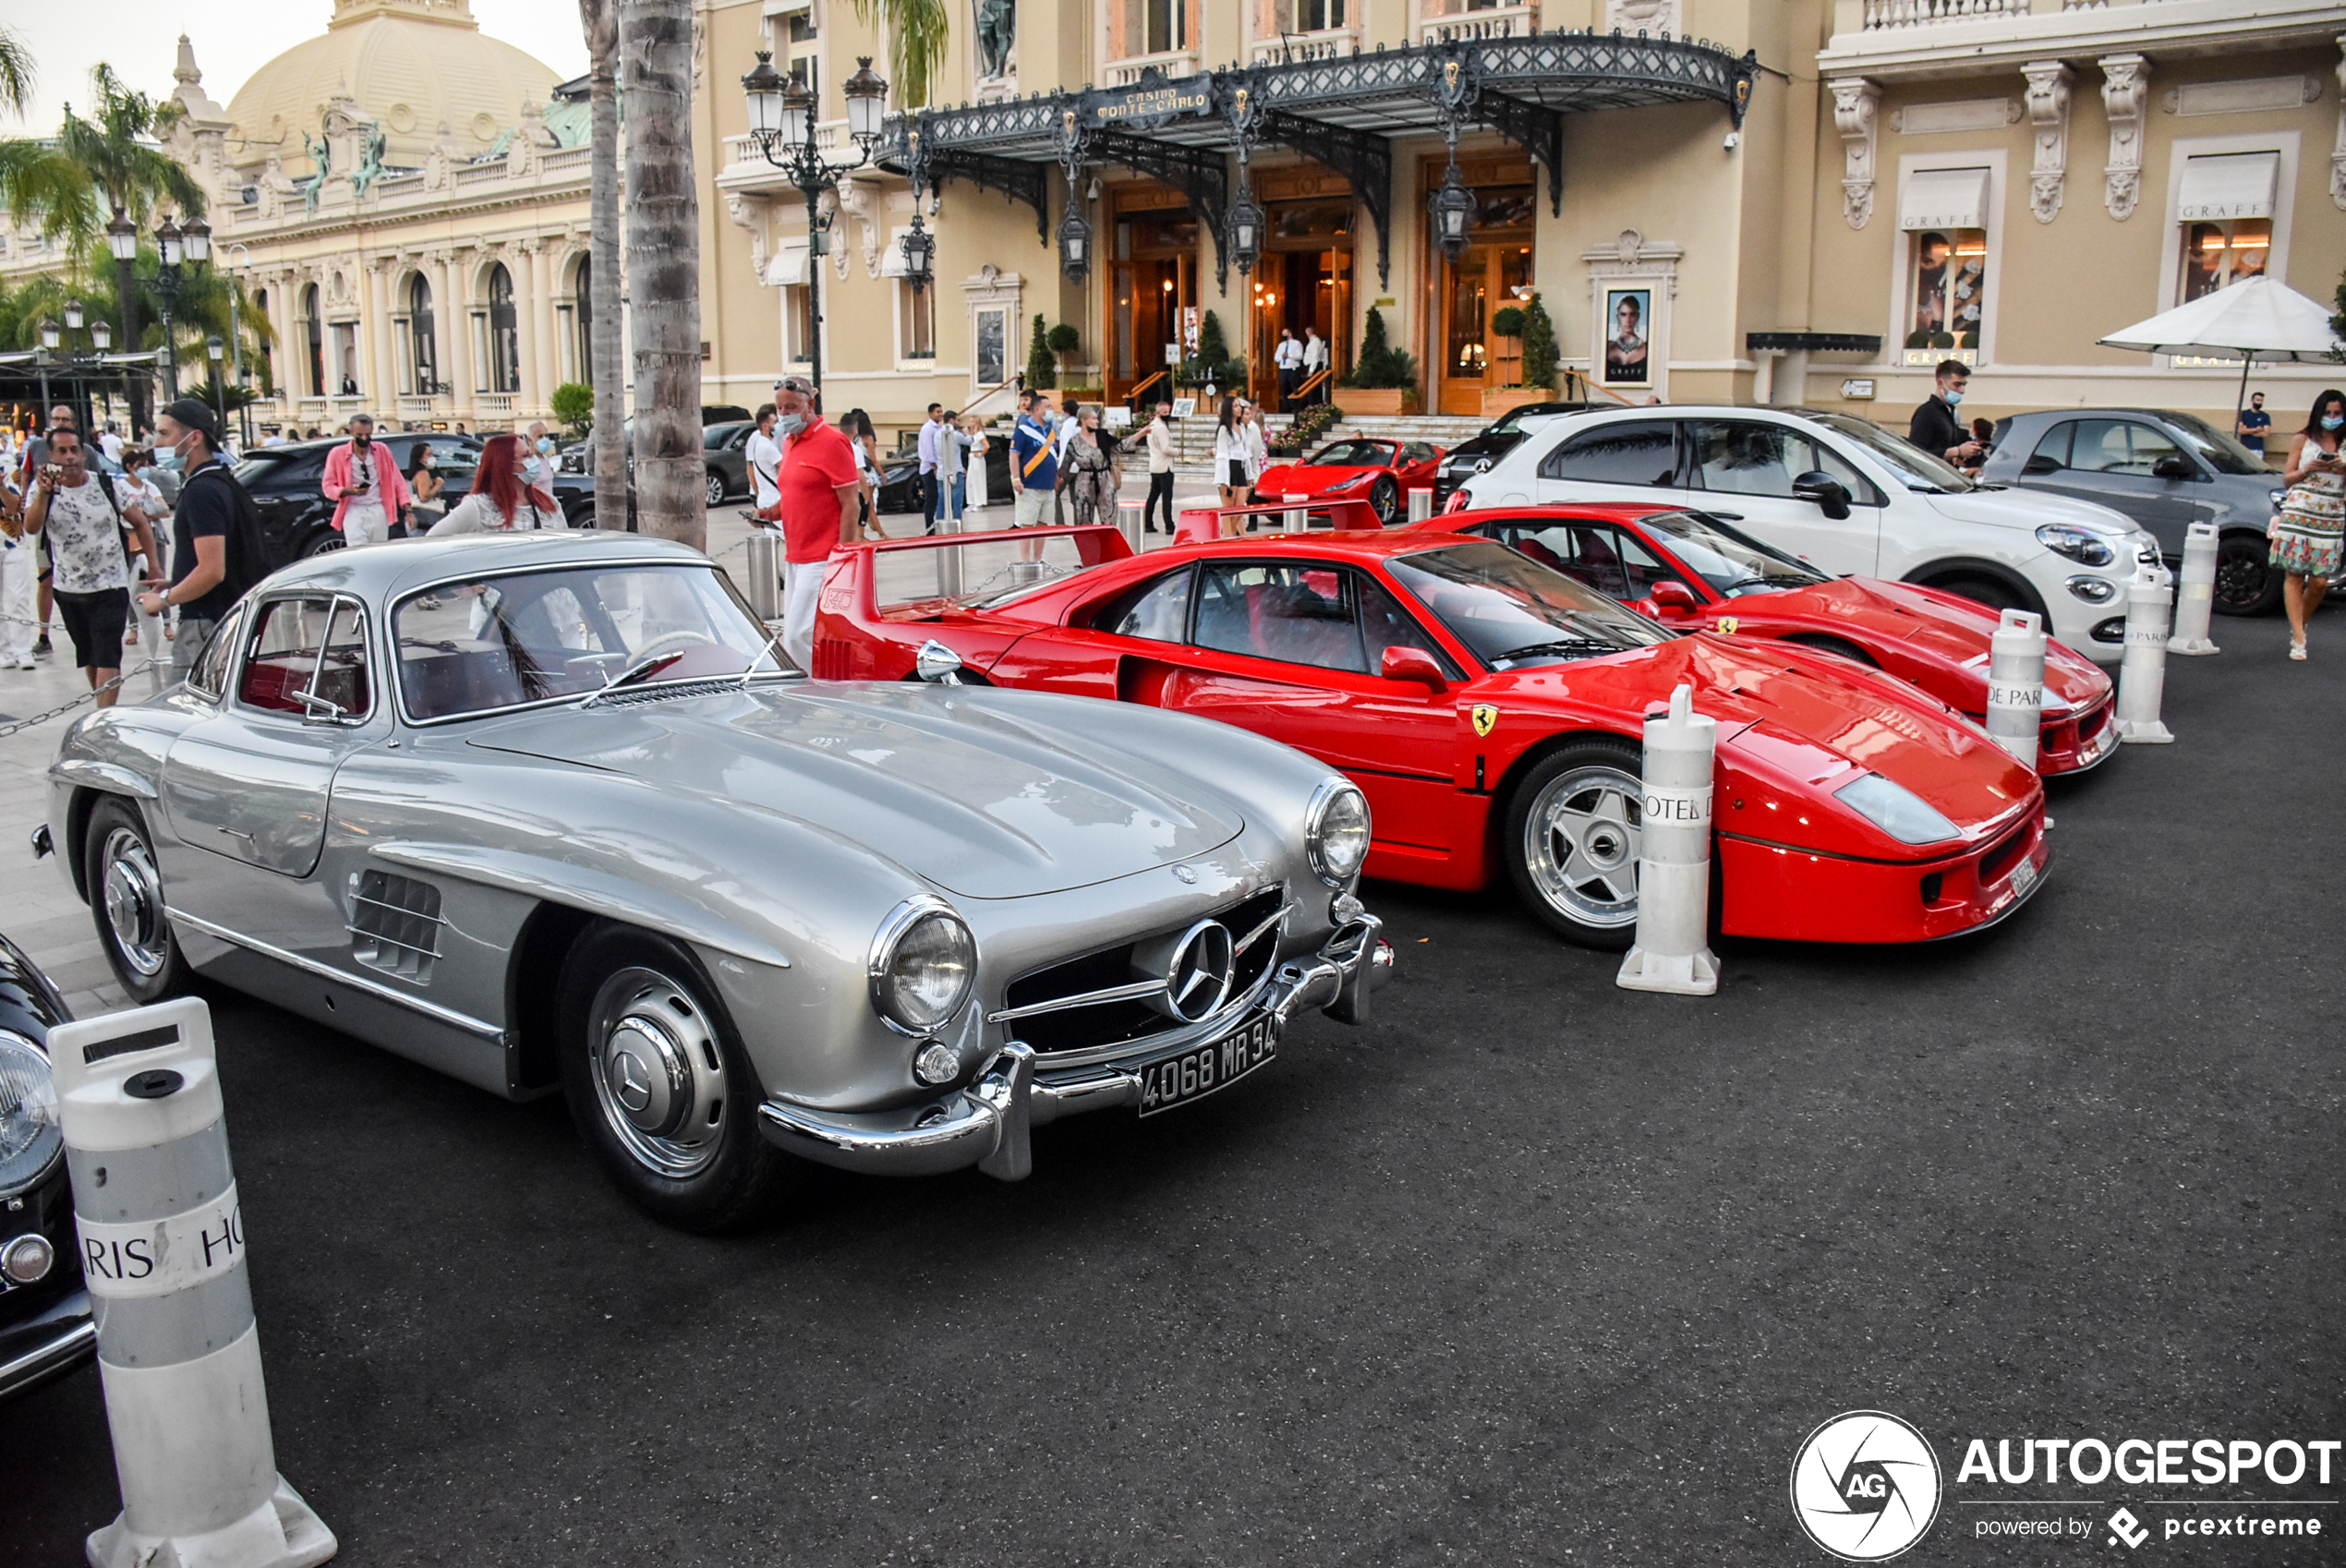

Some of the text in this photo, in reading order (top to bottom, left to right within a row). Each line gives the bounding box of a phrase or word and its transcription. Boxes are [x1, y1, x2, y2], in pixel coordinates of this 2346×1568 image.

[1126, 88, 1177, 104] CASINO
[2183, 203, 2260, 218] GRAFF
[1905, 214, 1972, 227] GRAFF
[1906, 352, 1971, 364] GRAFF
[1610, 368, 1642, 376] GRAFF
[1143, 1016, 1276, 1107] 4068 MR 94
[81, 1237, 153, 1279] RIS
